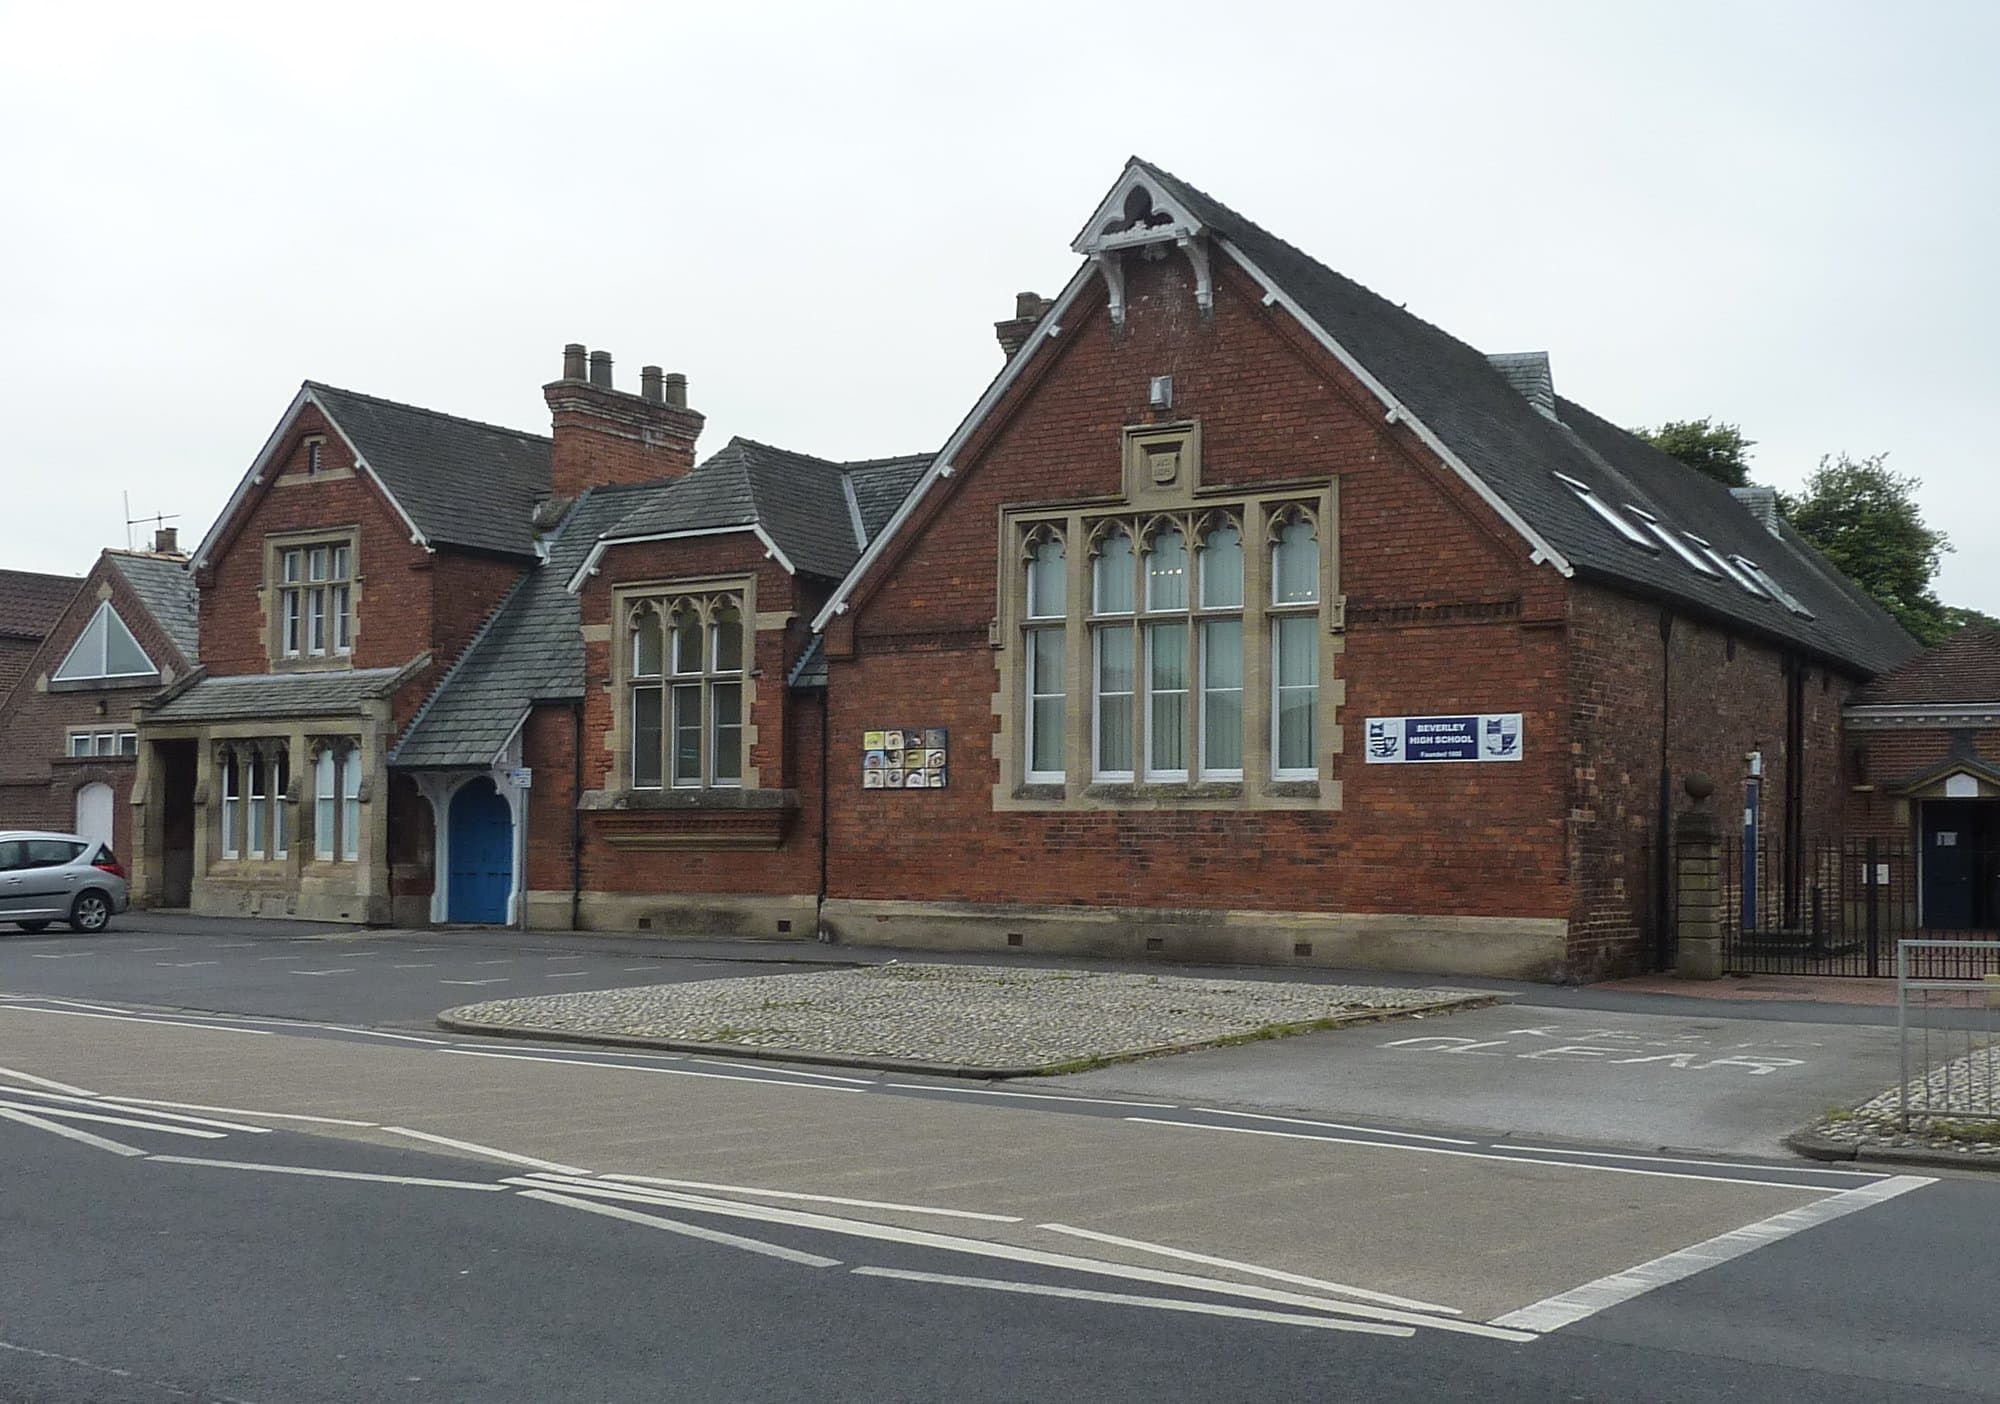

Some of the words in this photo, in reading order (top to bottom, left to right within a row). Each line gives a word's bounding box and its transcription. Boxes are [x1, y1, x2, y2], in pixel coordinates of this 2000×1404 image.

[1416, 723, 1466, 733] BEVERLEY
[1409, 736, 1433, 744] HIGH
[1434, 735, 1474, 744] SCHOOL
[1376, 1036, 1806, 1075] CLEAR
